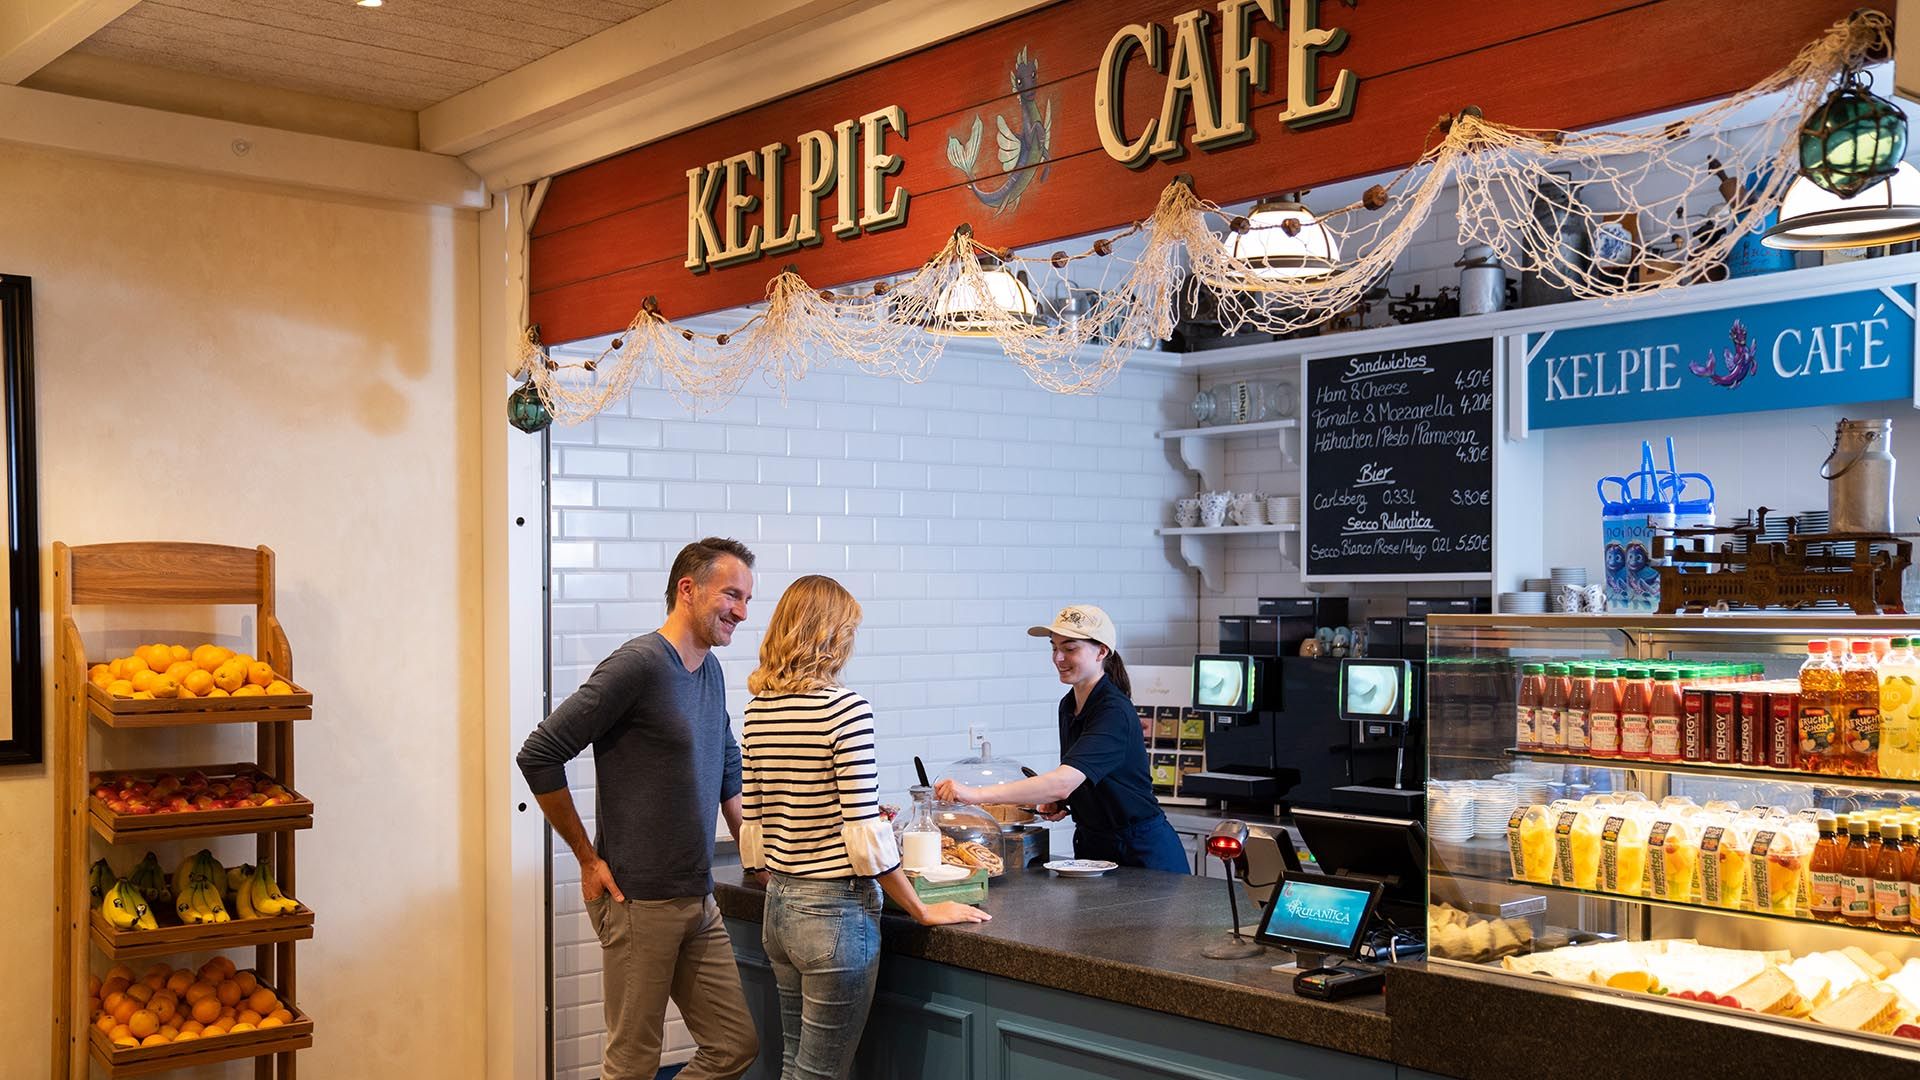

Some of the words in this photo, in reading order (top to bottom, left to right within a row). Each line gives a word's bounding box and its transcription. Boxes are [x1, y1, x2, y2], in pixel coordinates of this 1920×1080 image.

[685, 104, 907, 273] KELPIE
[1345, 352, 1427, 376] Sandwiches
[1545, 343, 1682, 402] KELPIE
[1772, 303, 1891, 379] CAFÉ
[1316, 385, 1347, 405] Ham
[1361, 381, 1410, 400] Cheese
[1455, 369, 1491, 390] 4,50€
[1239, 384, 1247, 421] HONIG
[1363, 403, 1376, 423] &
[1380, 394, 1455, 421] Mozzarella
[1461, 393, 1492, 414] 4,20€
[1356, 462, 1393, 483] Bier
[1314, 488, 1368, 514] Carlsberg
[1450, 489, 1490, 505] 3,80€
[1342, 517, 1378, 530] Secco
[1380, 510, 1434, 530] Rulantica
[1310, 544, 1340, 560] Secco
[1686, 713, 1696, 759] ENERGY
[1716, 714, 1727, 761] ENERGY
[1742, 716, 1751, 763] ENERGY
[1775, 717, 1785, 765] ENERGY
[1814, 873, 1833, 882] hohes
[1834, 873, 1840, 883] C
[1851, 878, 1856, 887] C
[1894, 882, 1899, 891] C
[1295, 905, 1351, 923] RULANTICA
